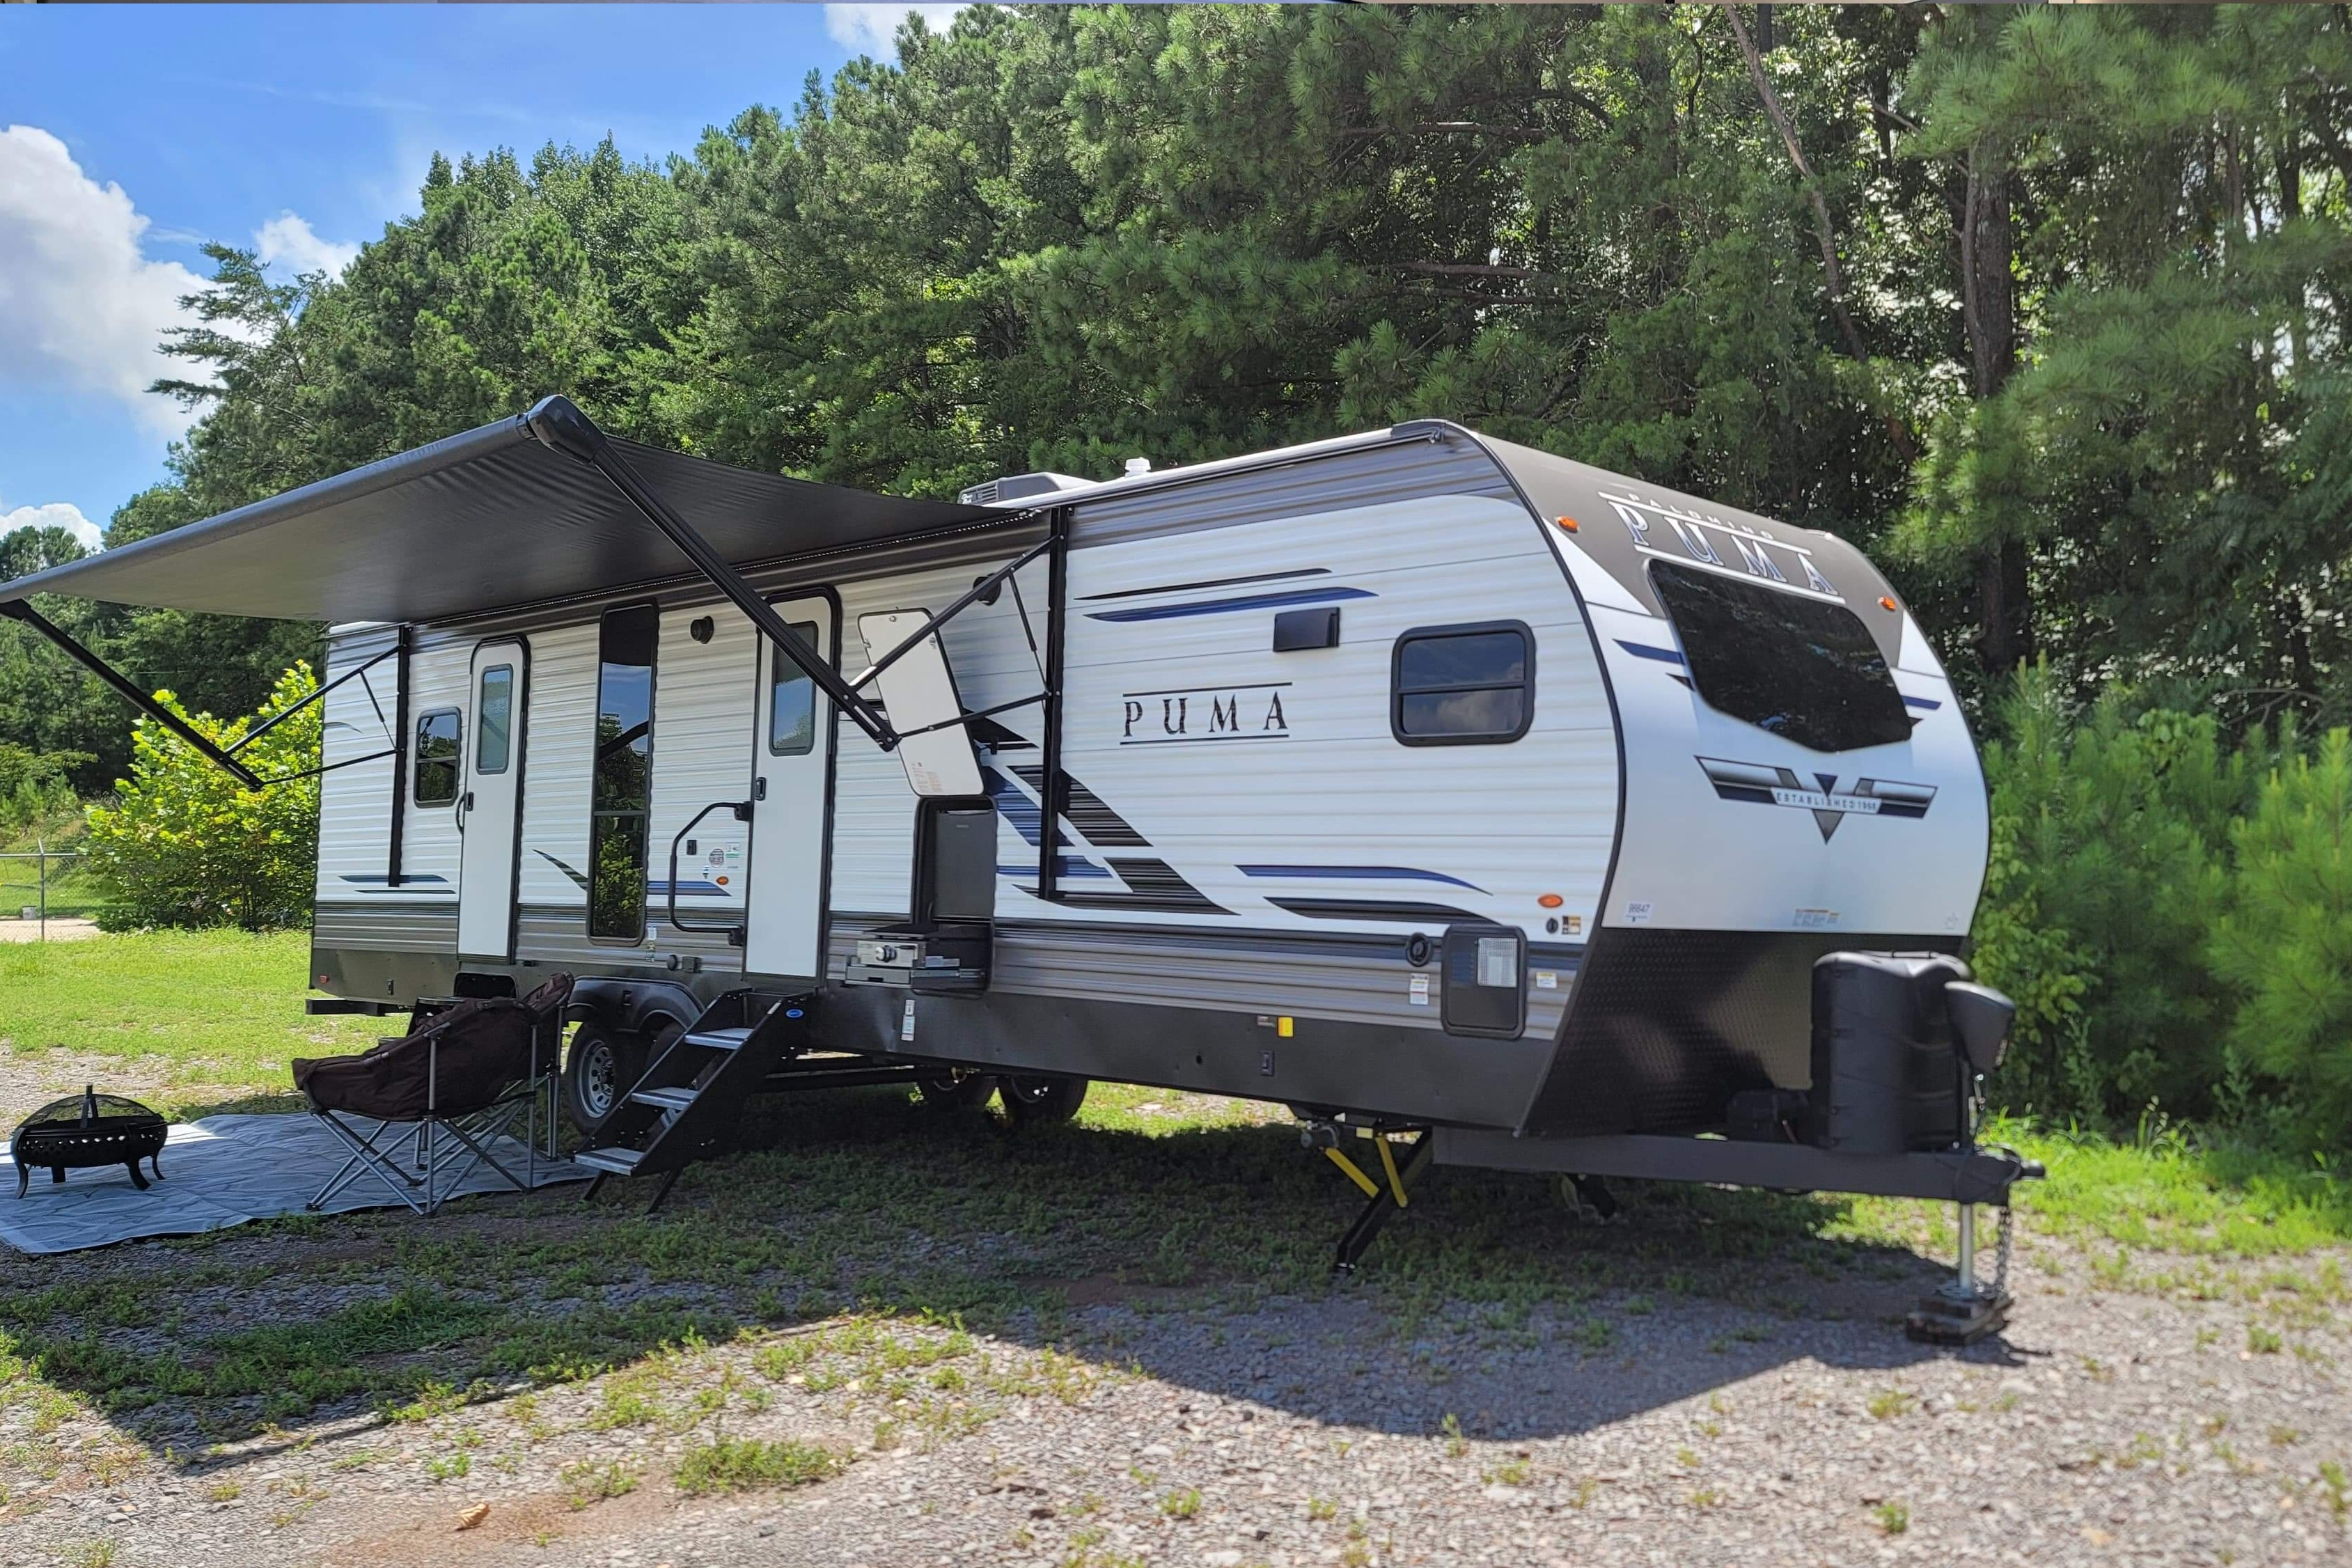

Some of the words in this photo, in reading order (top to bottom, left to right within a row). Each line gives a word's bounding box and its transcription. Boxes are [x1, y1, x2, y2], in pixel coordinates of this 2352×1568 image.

[1627, 492, 1775, 540] PALOMINO
[1606, 500, 1840, 596] PUMA
[1122, 690, 1289, 737] PUMA
[1776, 791, 1854, 809] ESTABLISHED
